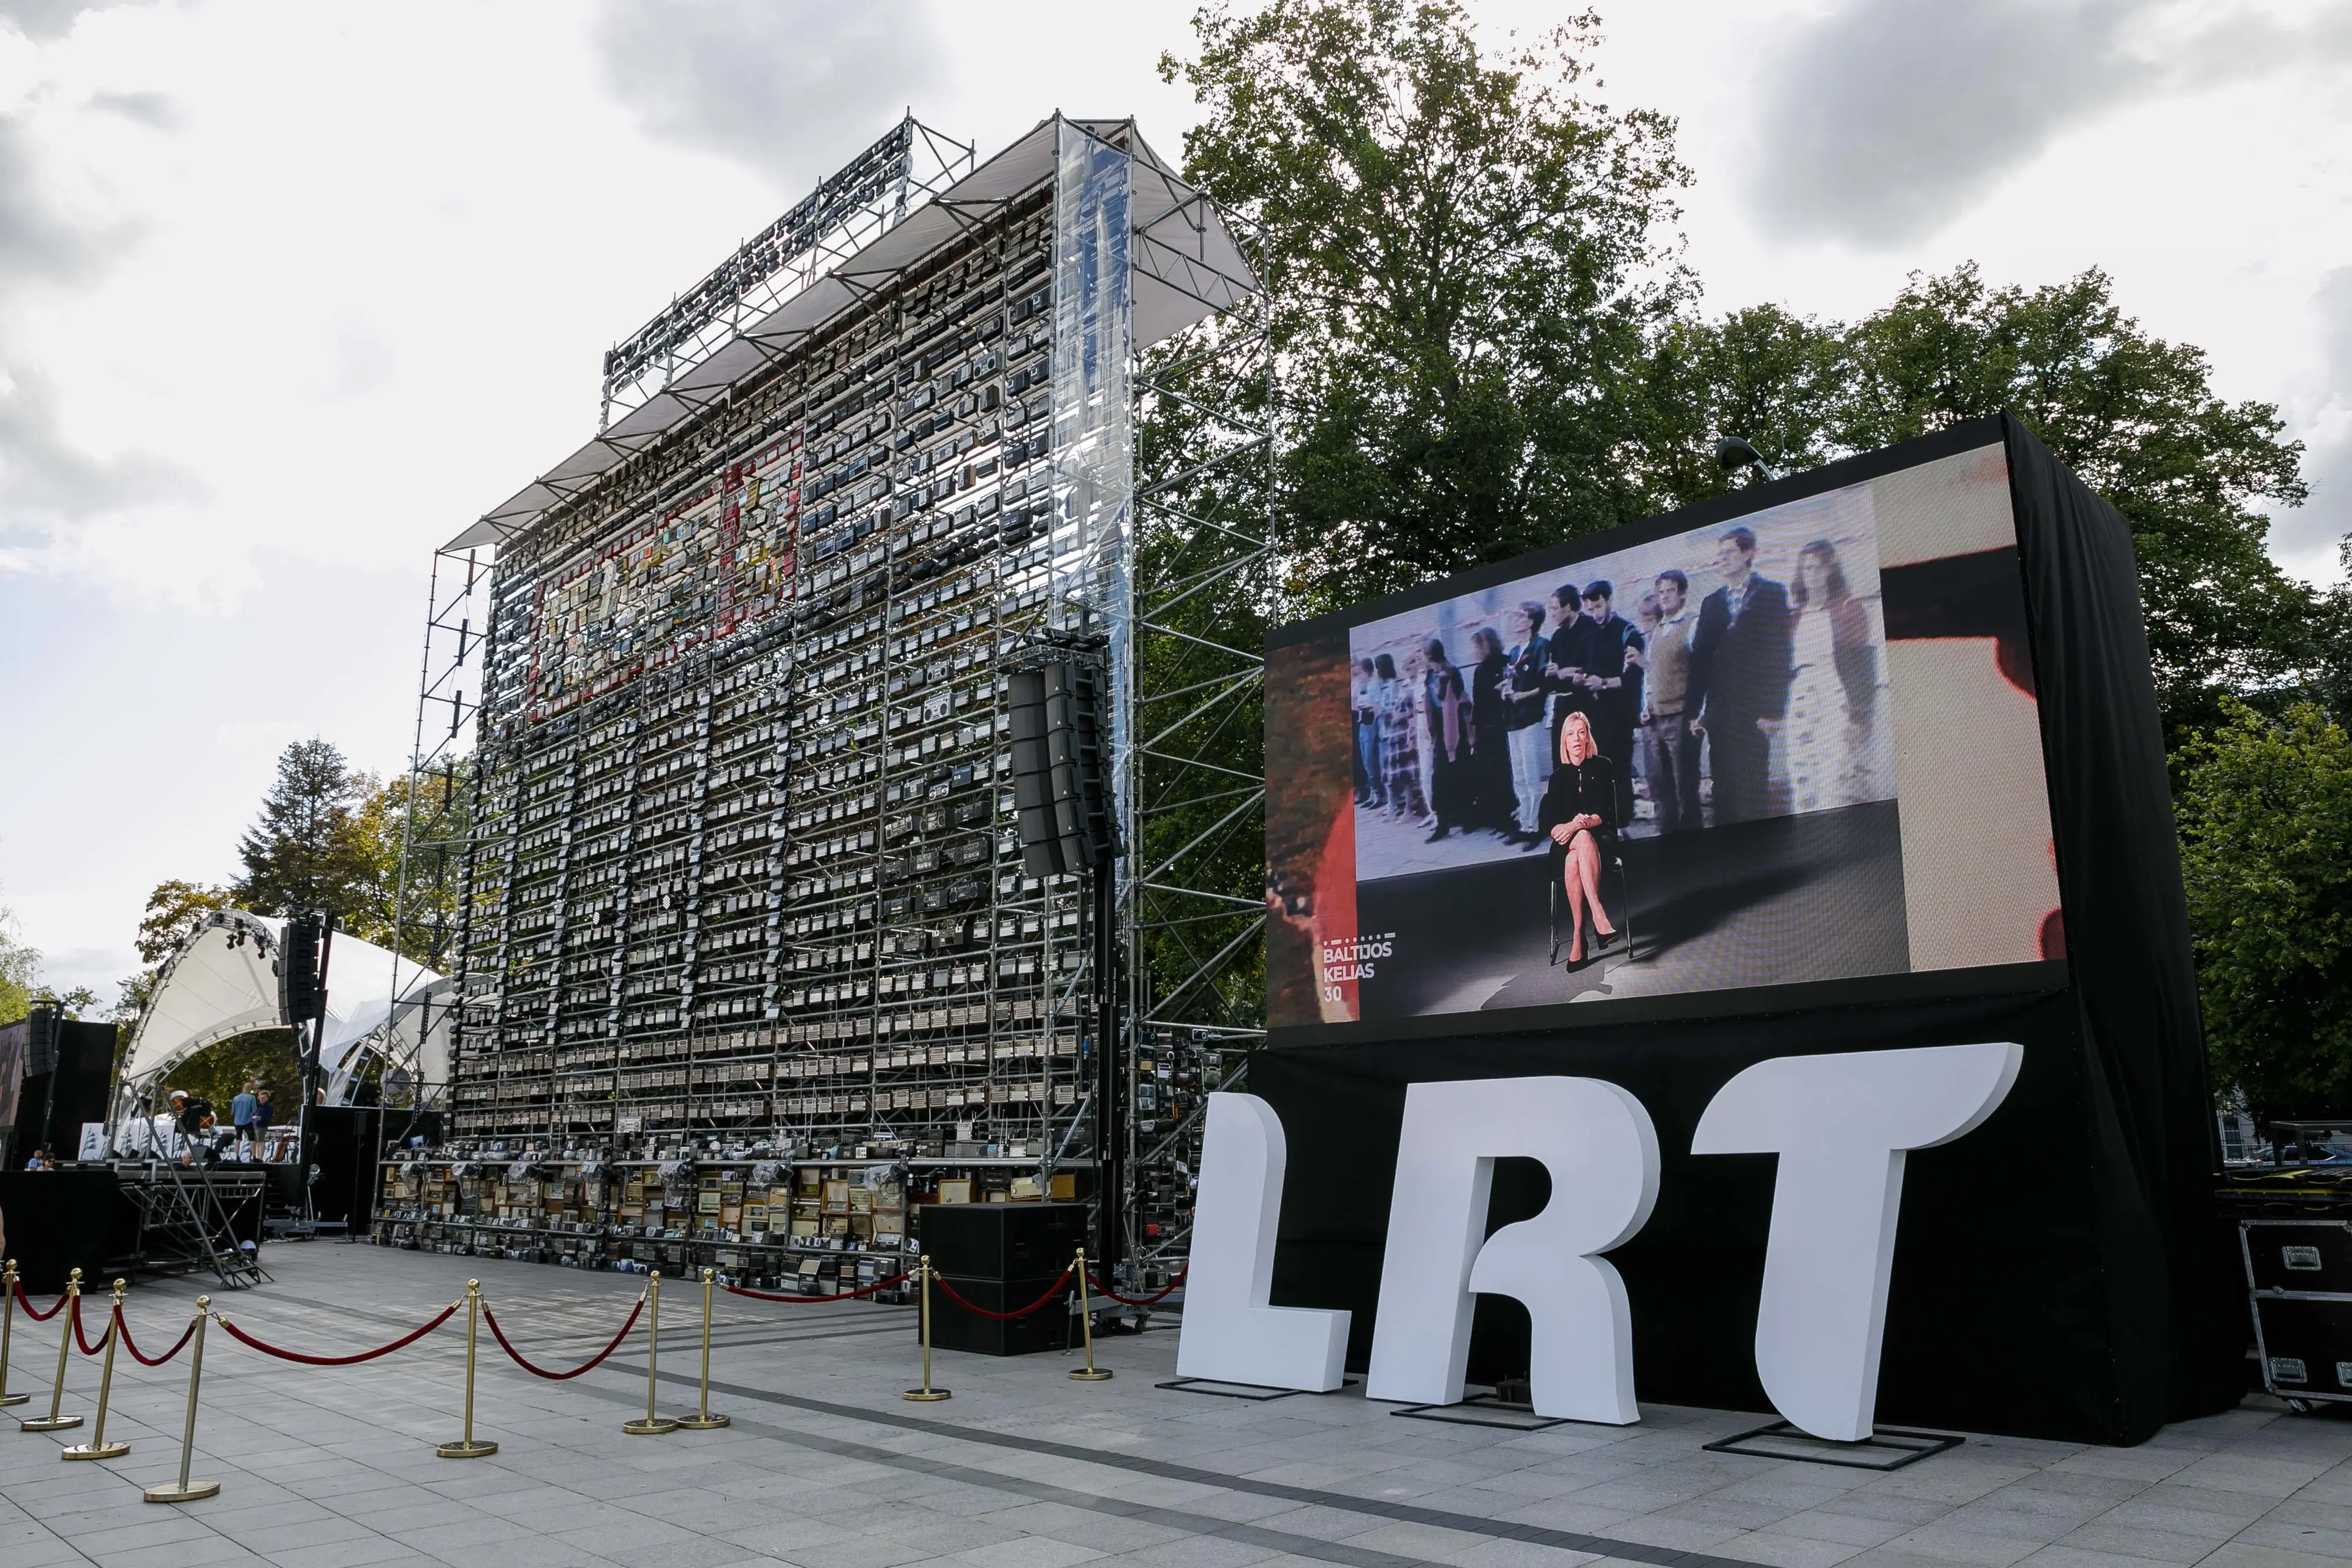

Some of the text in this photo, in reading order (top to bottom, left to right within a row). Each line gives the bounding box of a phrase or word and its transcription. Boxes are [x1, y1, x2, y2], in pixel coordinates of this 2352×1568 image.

[1323, 941, 1392, 964] BALTIJOS
[1324, 963, 1375, 983] KELIAS
[1324, 986, 1342, 1003] 30
[1177, 1041, 2024, 1442] LRT
